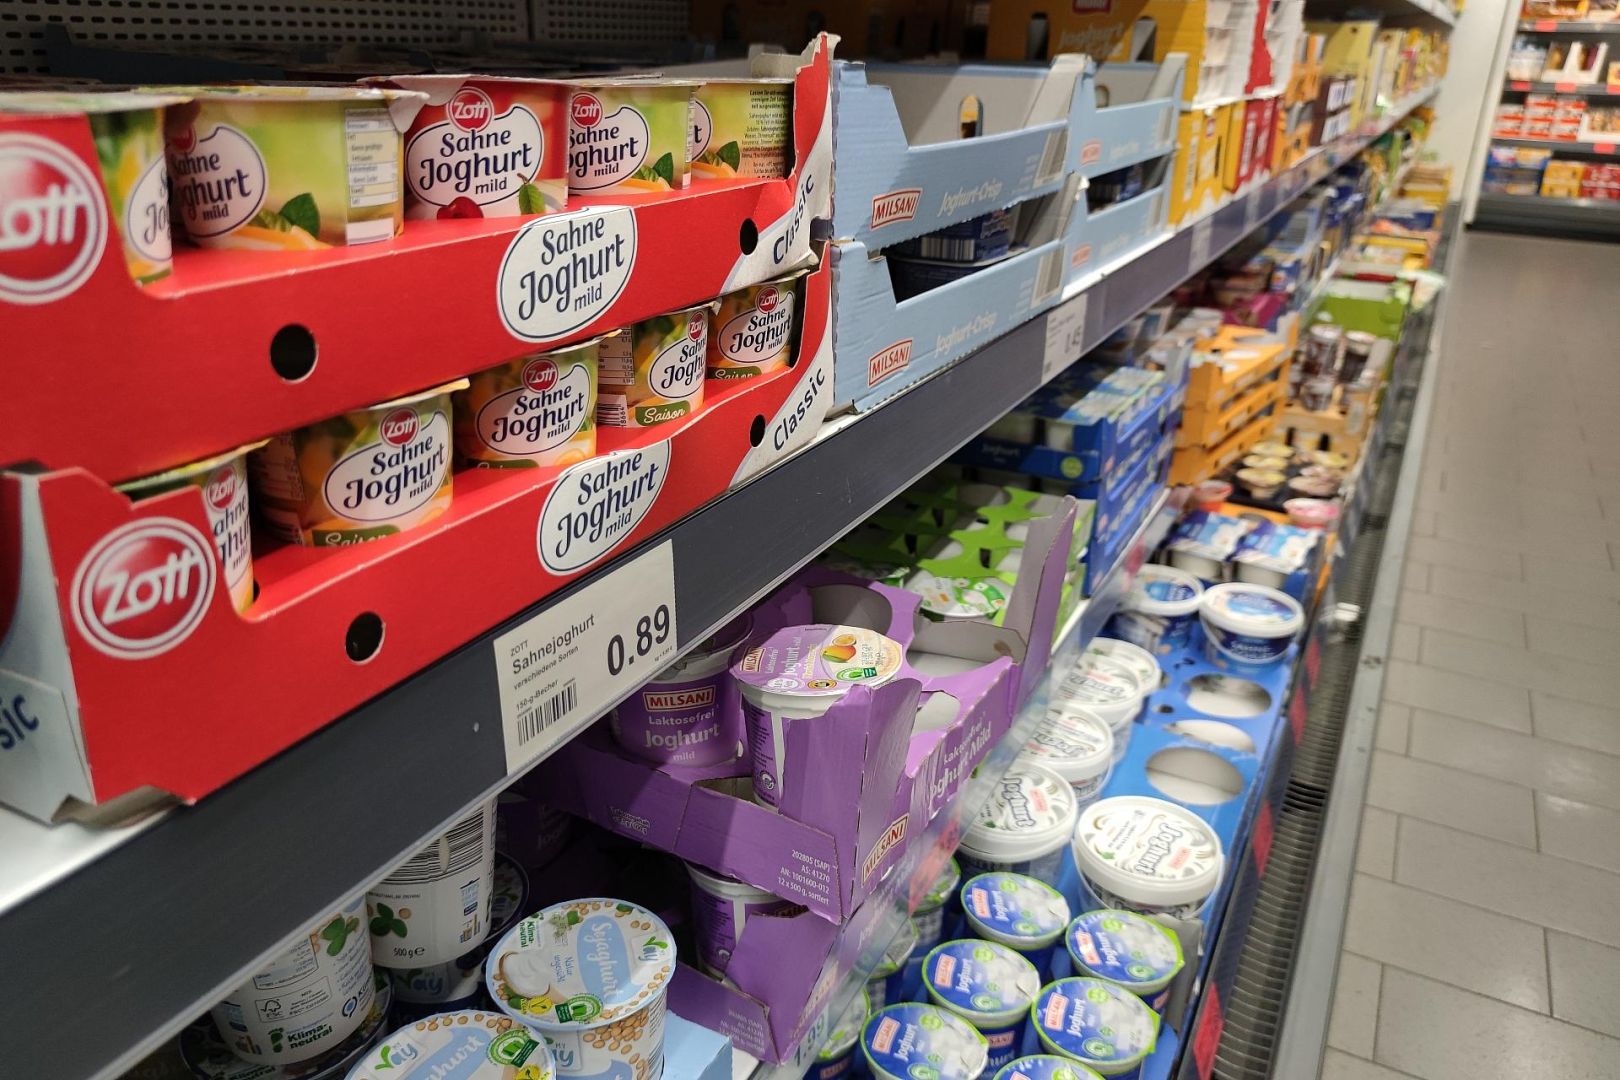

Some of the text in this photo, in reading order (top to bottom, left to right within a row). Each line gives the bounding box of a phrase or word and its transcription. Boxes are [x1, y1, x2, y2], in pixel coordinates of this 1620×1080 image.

[454, 100, 487, 119] Zott
[573, 102, 600, 118] Zott
[440, 128, 511, 157] Sahne
[419, 143, 532, 193] Joghurt
[593, 162, 620, 177] mild
[475, 176, 508, 195] mild
[0, 183, 87, 250] ott
[202, 203, 230, 221] mild
[773, 173, 815, 265] Classic
[874, 194, 917, 222] MILSANI
[541, 216, 605, 265] Sahne
[518, 233, 626, 321] Joghurt
[573, 281, 602, 312] mild
[729, 313, 792, 354] Joghurt
[747, 307, 786, 332] Sahne
[767, 335, 783, 350] mild
[528, 367, 557, 384] Zott
[871, 345, 910, 379] MILSANI
[514, 385, 572, 416] Sahne
[773, 367, 825, 451] Classic
[386, 416, 416, 438] Zott
[491, 392, 585, 443] Joghurt
[547, 420, 571, 439] mild
[643, 407, 686, 424] Saison
[370, 436, 434, 477] Sahne
[343, 442, 446, 509] Joghurt
[409, 475, 433, 500] mild
[577, 452, 643, 506] Sahne
[555, 463, 659, 558] Joghurt
[605, 508, 633, 538] mild
[98, 547, 202, 626] Zott
[510, 640, 529, 657] ZOTT
[512, 613, 595, 675] Sahnejoghurt
[607, 604, 671, 676] 0.89
[513, 645, 580, 690] verschiedene Sorten
[649, 690, 711, 707] MILSANI
[648, 706, 715, 726] Laktosefrei
[644, 723, 721, 752] Joghurt
[672, 751, 696, 761] mild
[791, 849, 815, 863] 202805
[864, 822, 905, 876] MILSANI
[780, 866, 791, 878] AN:
[801, 864, 831, 883] AS: 41270
[790, 881, 802, 893] 500
[991, 890, 1010, 922] Joghurt
[519, 921, 529, 948] neutral
[1095, 931, 1121, 967] Joghurt
[393, 947, 407, 957] 500
[955, 958, 974, 994] Joghurt
[1066, 997, 1087, 1038] Joghurt
[286, 1022, 328, 1043] Klima-
[289, 1025, 334, 1050] neutral
[893, 1022, 919, 1063] Joghurt
